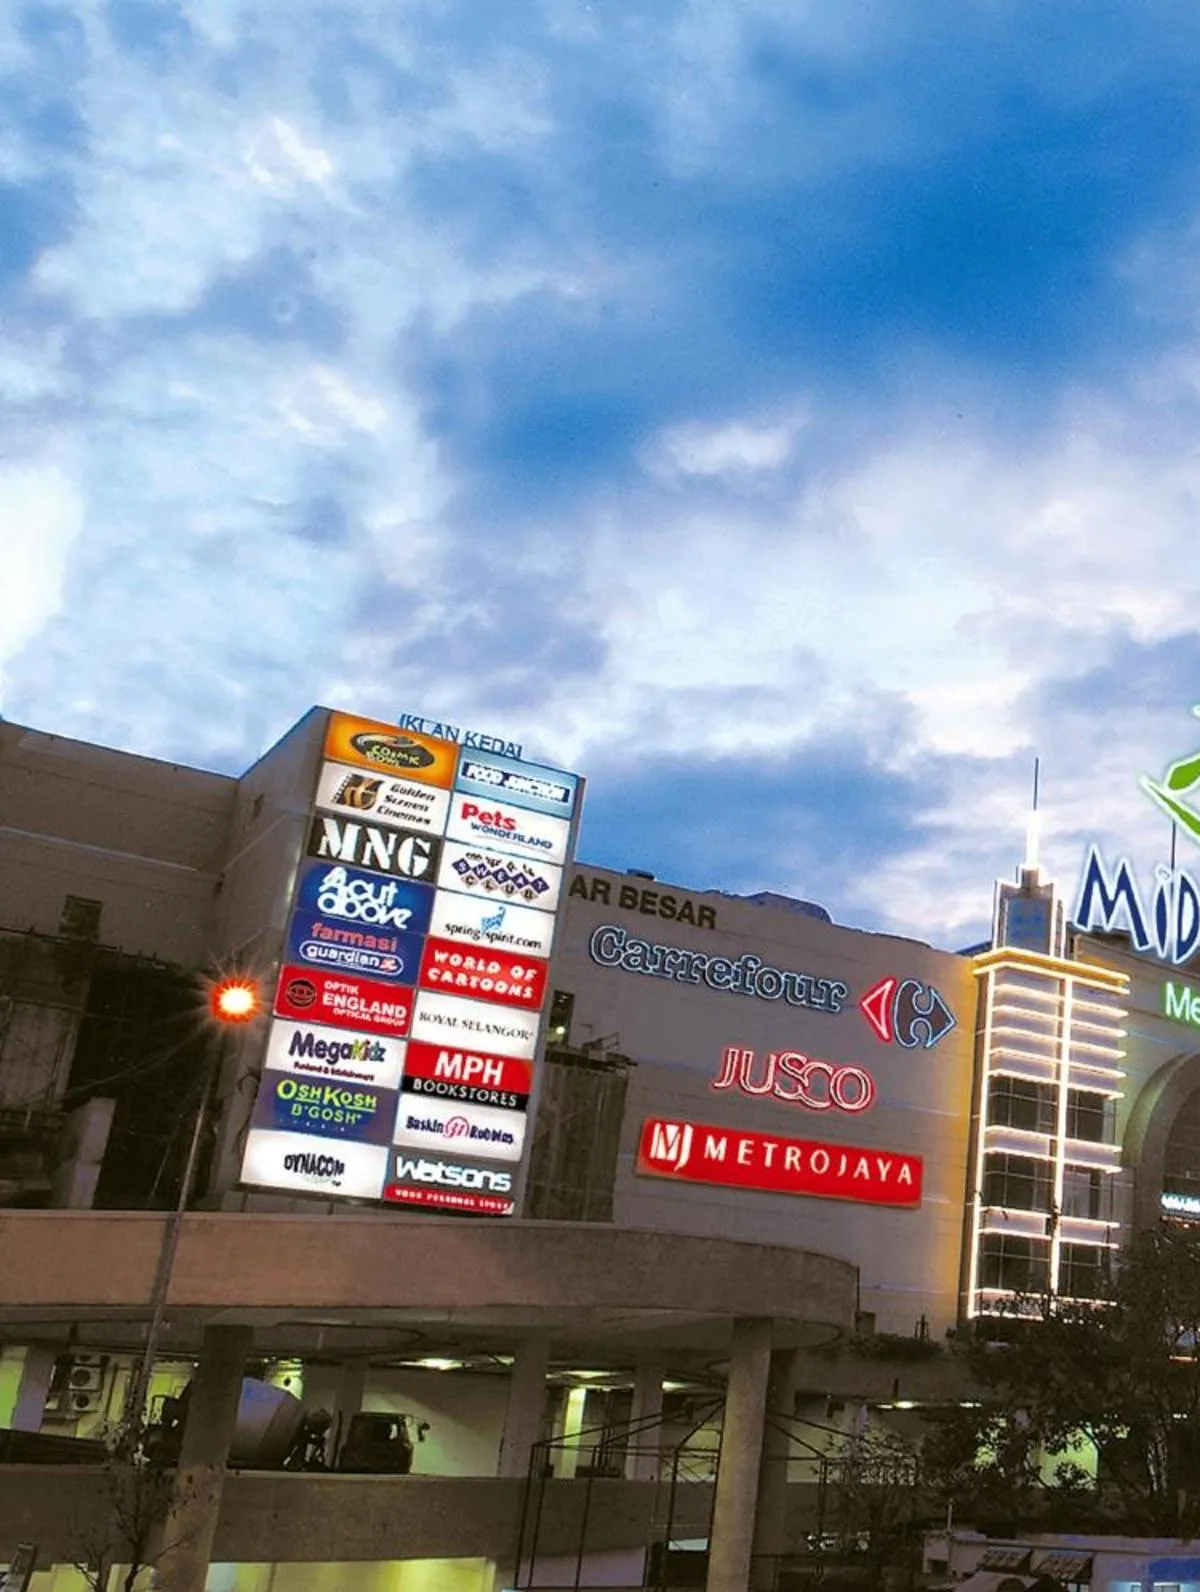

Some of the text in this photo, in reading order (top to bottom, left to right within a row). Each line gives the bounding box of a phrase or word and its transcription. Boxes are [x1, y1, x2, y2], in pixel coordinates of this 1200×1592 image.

[390, 784, 436, 802] Golden
[377, 805, 431, 825] Cinemas
[461, 803, 516, 830] Pets
[317, 817, 432, 877] MNG
[471, 822, 553, 849] WONDERLAND
[457, 860, 546, 890] SWEAT
[317, 893, 413, 929] above
[618, 884, 718, 930] BESAR
[312, 922, 398, 952] farmasi
[306, 944, 380, 967] guardian
[434, 949, 538, 982] WORLD OF
[589, 923, 848, 1014] Carrefour
[324, 980, 360, 995] OPTIK
[427, 967, 534, 999] CARTOONS
[322, 992, 408, 1019] ENGLAND
[332, 1007, 405, 1027] OPTICAL GROUP
[419, 1012, 530, 1040] ROYAL SELANGOR
[434, 1050, 505, 1086] MPH
[712, 1045, 875, 1114] JUSCO
[413, 1078, 518, 1107] BOOKSTORES
[406, 1115, 444, 1134] Baskin
[469, 1125, 514, 1145] Robbins
[703, 1134, 914, 1186] METROJAYA
